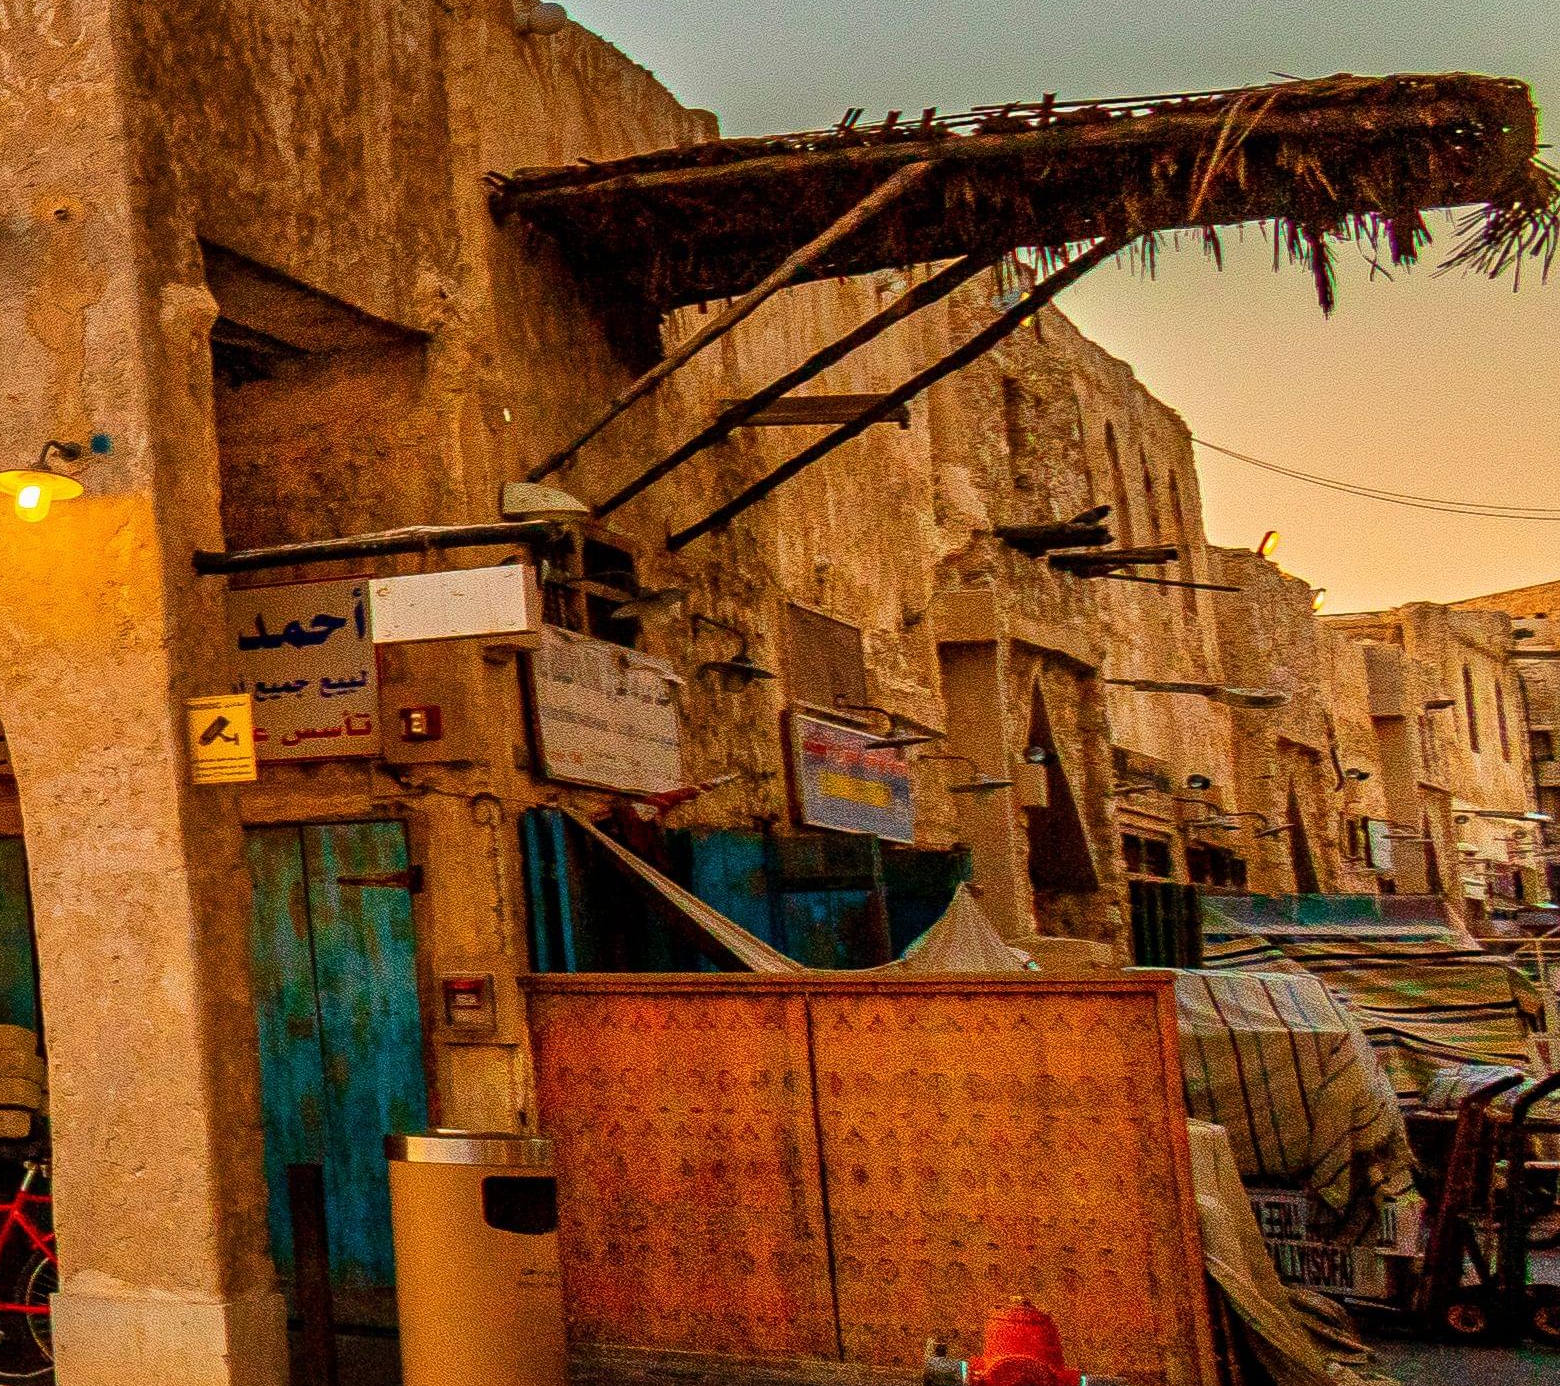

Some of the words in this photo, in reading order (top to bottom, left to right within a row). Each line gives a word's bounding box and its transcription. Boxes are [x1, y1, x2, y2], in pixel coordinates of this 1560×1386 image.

[238, 588, 366, 650] أحمد
[254, 679, 310, 702] جميع
[320, 670, 368, 698] لبيع
[281, 711, 372, 746] تأسس
